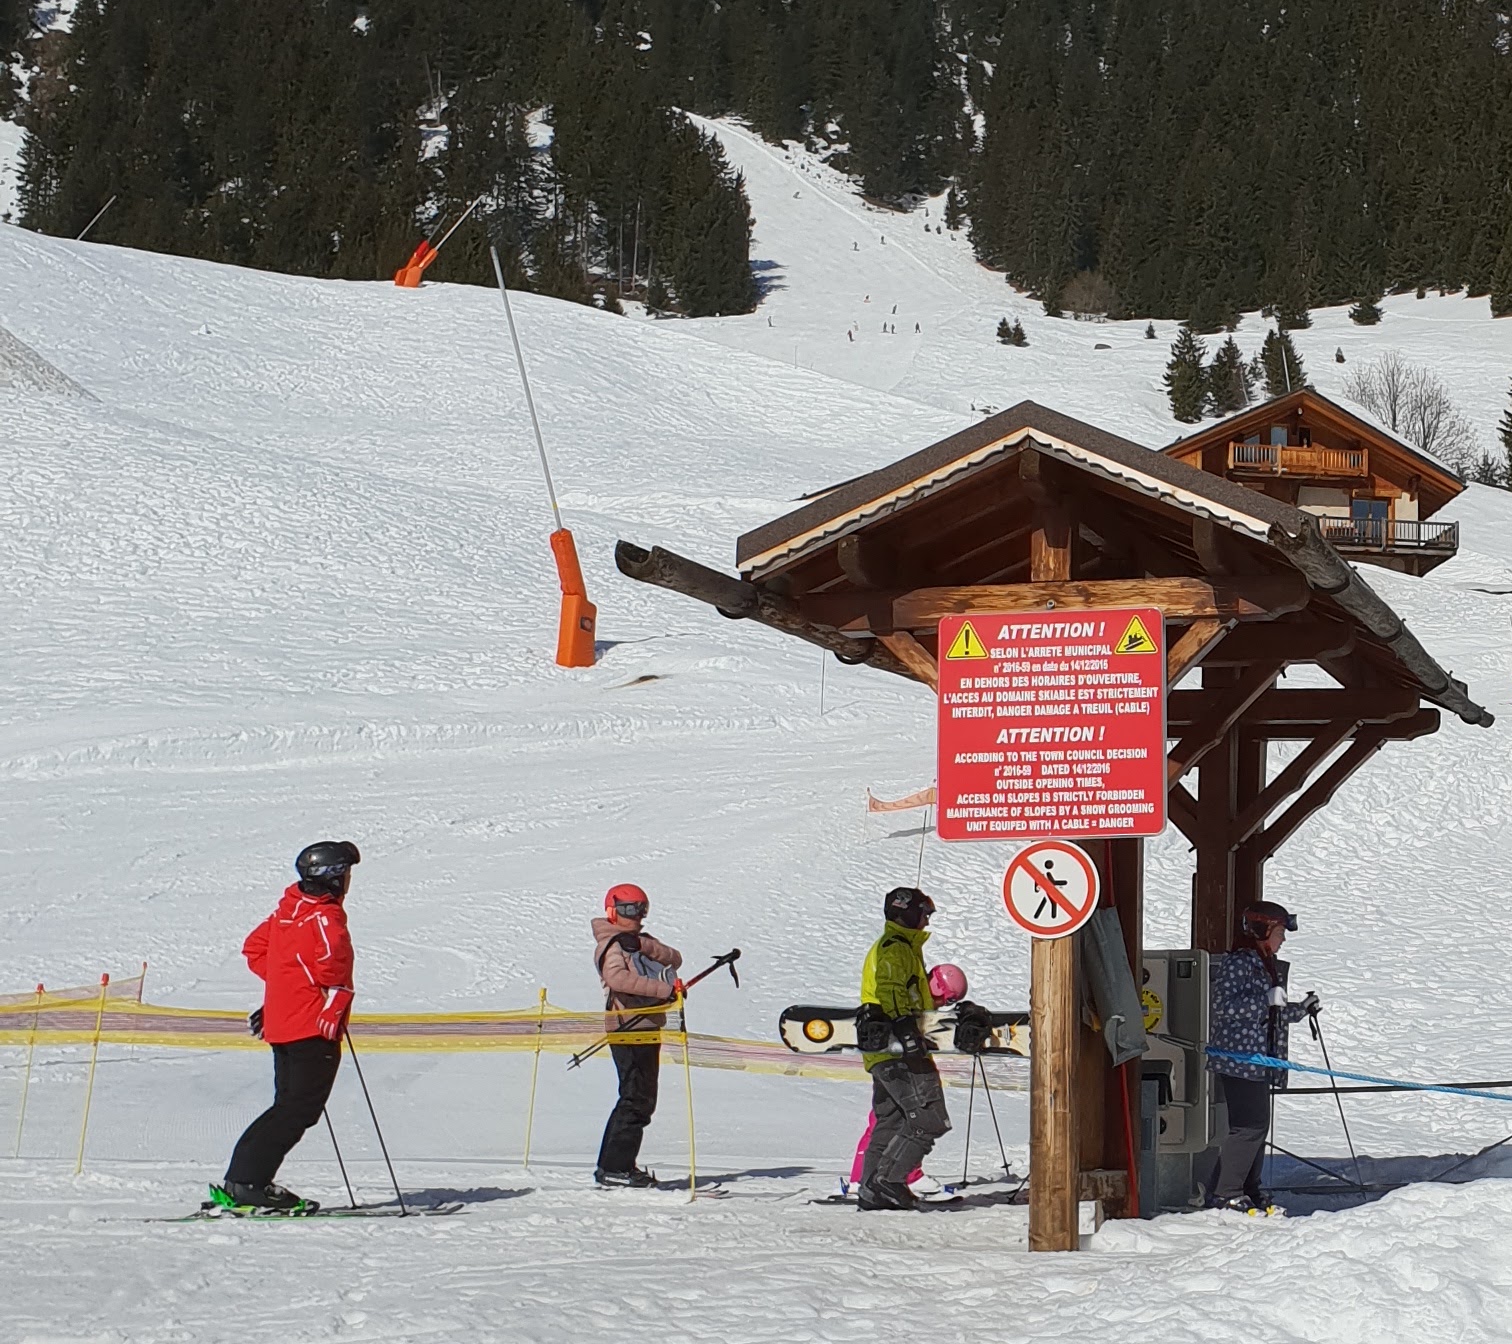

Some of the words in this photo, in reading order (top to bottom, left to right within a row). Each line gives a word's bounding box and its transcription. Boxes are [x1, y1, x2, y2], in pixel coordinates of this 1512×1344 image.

[998, 622, 1094, 639] ATTENTION
[1099, 622, 1105, 636] !
[990, 647, 1018, 658] SELON
[1021, 646, 1062, 657] L'ARRETE
[1065, 644, 1112, 656] MUNICIPAL
[1043, 661, 1058, 671] date
[1060, 661, 1069, 671] du
[960, 678, 972, 688] EN
[975, 677, 1009, 688] DEHORS
[1012, 677, 1029, 687] DES
[1032, 675, 1075, 686] HORAIRES
[1078, 673, 1142, 685] D'OUVERTURE,
[944, 693, 979, 703] L'ACCES
[981, 693, 993, 702] AU
[996, 691, 1035, 702] DOMAINE
[1038, 690, 1076, 701] SKIABLE
[1078, 689, 1094, 699] EST
[1097, 687, 1158, 699] STRICTEMENT
[952, 707, 994, 719] INTERDIT,
[997, 705, 1032, 717] DANGER
[1034, 704, 1070, 715] DAMAGE
[1073, 704, 1079, 714] A
[1081, 703, 1113, 714] TREUIL
[1115, 702, 1149, 715] (CABLE)
[997, 727, 1094, 744] ATTENTION
[1098, 727, 1105, 740] !
[955, 753, 1004, 763] ACCORDING
[1007, 752, 1018, 762] TO
[1021, 751, 1037, 761] THE
[1039, 750, 1064, 761] TOWN
[1067, 749, 1104, 760] COUNCIL
[1107, 748, 1147, 759] DECISION
[1042, 764, 1070, 775] DATED
[997, 778, 1033, 789] OUTSIDE
[1036, 778, 1073, 788] OPENING
[1076, 777, 1105, 789] TIMES,
[957, 794, 990, 805] ACCESS
[993, 793, 1005, 803] ON
[1008, 792, 1039, 803] SLOPES
[1042, 792, 1050, 802] IS
[1053, 791, 1093, 802] STRICTLY
[1096, 790, 1144, 801] FORBIDDEN
[947, 807, 1008, 818] MAINTENANCE
[1011, 807, 1022, 816] OF
[1024, 806, 1056, 816] SLOPES
[1059, 805, 1070, 815] BY
[1072, 805, 1078, 815] A
[1081, 804, 1106, 815] SNOW
[1108, 803, 1154, 814] GROOMING
[967, 821, 987, 832] UNIT
[1029, 820, 1050, 830] WITH
[1053, 819, 1059, 829] A
[1062, 818, 1089, 829] CABLE
[1099, 818, 1134, 828] DANGER
